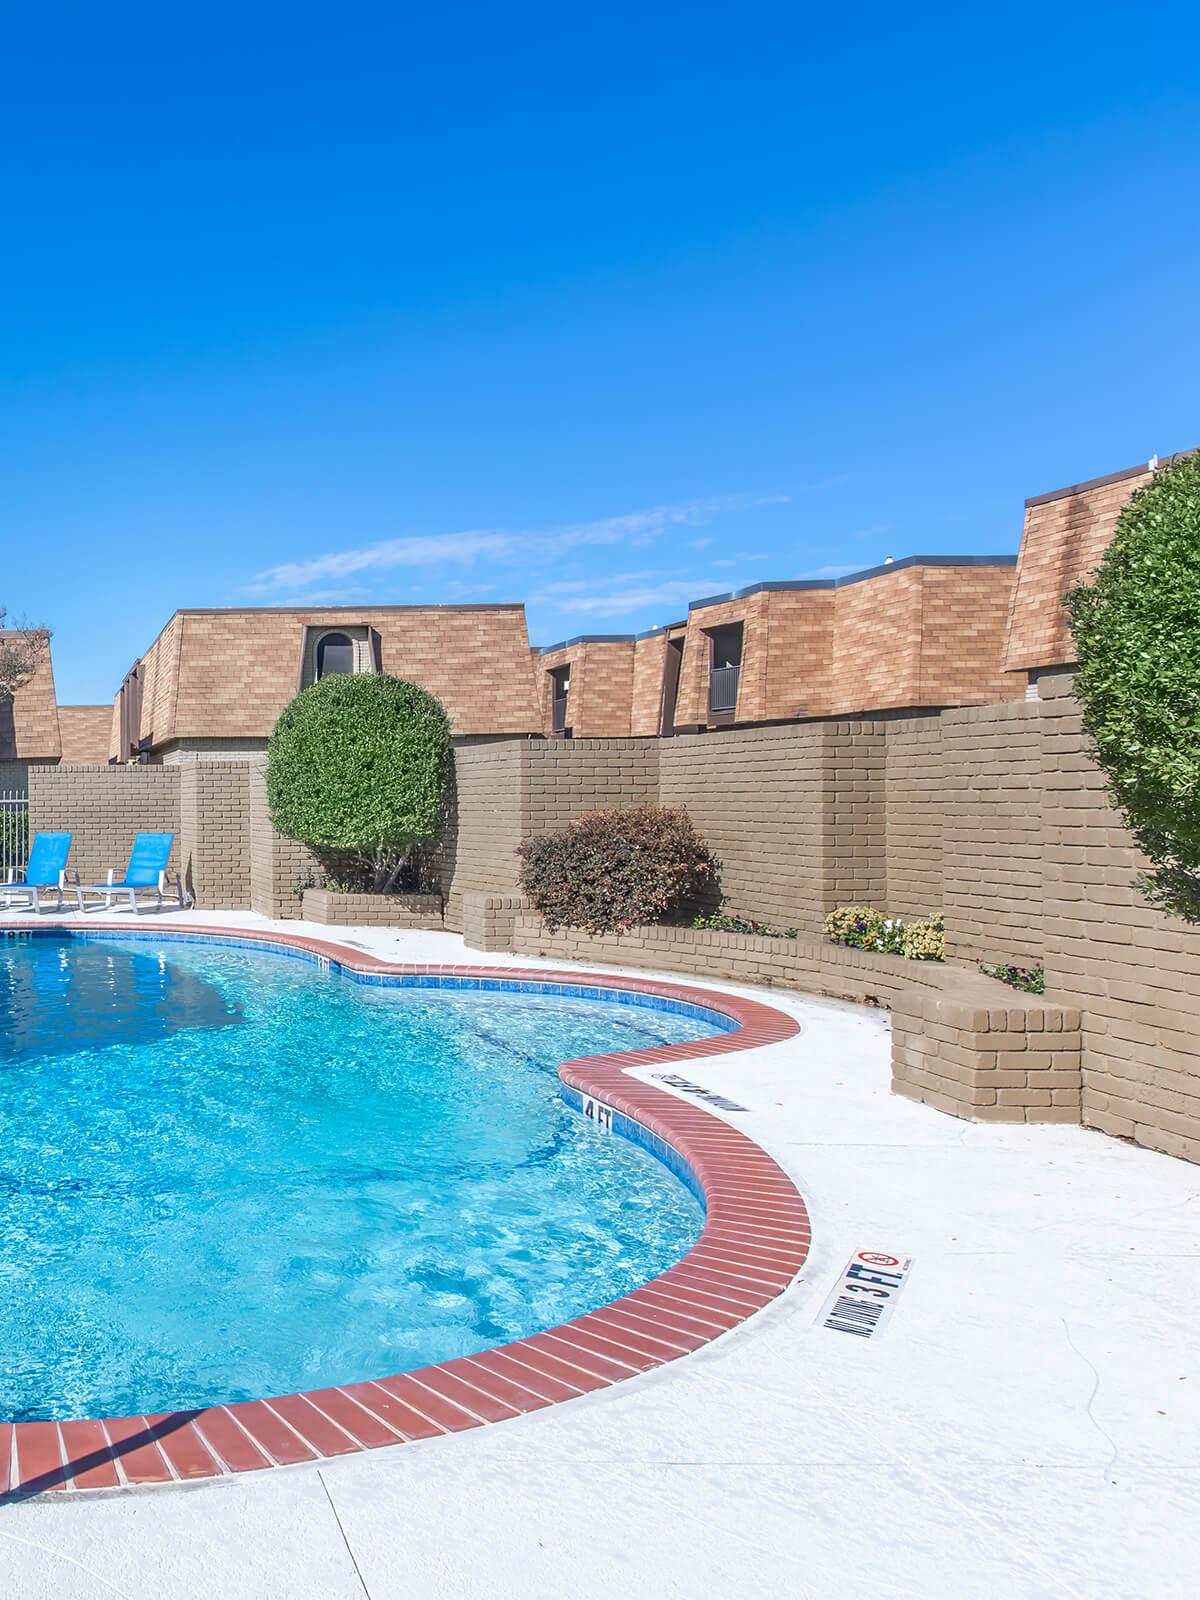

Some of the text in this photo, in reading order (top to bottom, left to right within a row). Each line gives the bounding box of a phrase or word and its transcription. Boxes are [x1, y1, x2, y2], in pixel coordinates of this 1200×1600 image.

[585, 1100, 611, 1129] 4 FT
[845, 1284, 890, 1298] 3
[829, 1295, 884, 1326] DIVING
[823, 1319, 873, 1338] NO
